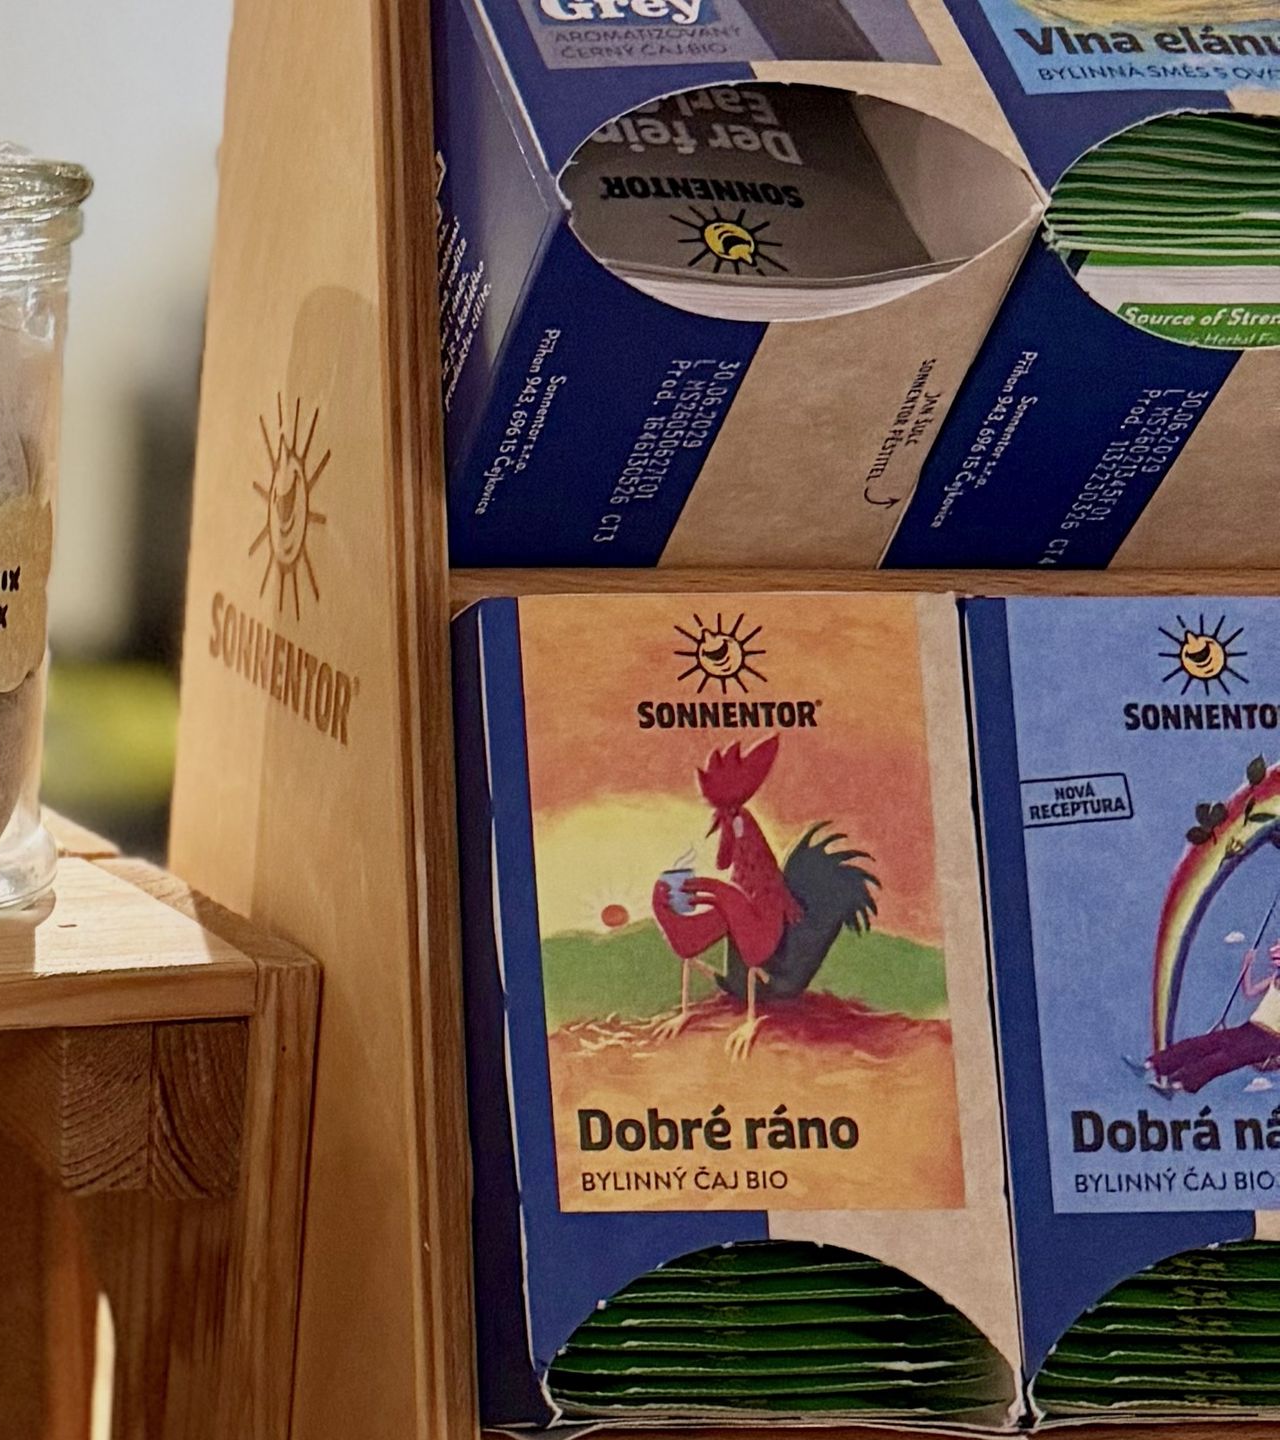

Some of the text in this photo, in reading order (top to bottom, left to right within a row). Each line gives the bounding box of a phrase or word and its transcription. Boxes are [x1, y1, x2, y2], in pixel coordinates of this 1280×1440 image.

[540, 0, 702, 25] Grey
[561, 42, 727, 60] ČERNÝ ČAJ BIO
[1014, 25, 1144, 56] Vlna
[1038, 61, 1141, 81] BYLINNÁ
[1146, 61, 1209, 79] SMĚS
[708, 123, 803, 166] Der
[606, 176, 805, 208] SONNENTOR
[1124, 306, 1196, 326] Source
[1200, 308, 1227, 326] of
[692, 359, 717, 368] L
[512, 377, 543, 408] 943,
[652, 360, 691, 406] Prod.
[893, 358, 937, 427] SONNENTOR
[1162, 389, 1186, 397] L
[529, 375, 567, 443] Sonnentor
[682, 360, 740, 449] 30.06.2029
[918, 392, 942, 415] JAN
[983, 395, 1014, 426] 943,
[1119, 389, 1162, 430] Prod.
[505, 410, 528, 438] 696
[991, 395, 1039, 459] Sonnentor
[1141, 390, 1209, 473] 30.06.2029
[499, 439, 518, 454] 15
[970, 428, 996, 453] 696
[962, 455, 982, 469] 15
[474, 454, 515, 516] Čejkovice
[593, 514, 622, 543] CT3
[1038, 538, 1069, 564] CT4
[209, 591, 352, 747] SONNENTOR
[637, 701, 818, 729] SONNENTOR
[1123, 702, 1280, 731] SONNENTO
[1054, 782, 1096, 801] NOVÁ
[1029, 797, 1127, 821] RECEPTURA
[577, 1104, 859, 1153] Dobré ráno
[1071, 1105, 1221, 1153] Dobrá
[581, 1166, 789, 1193] BYLINNÝ ČAJ BIO
[1075, 1166, 1276, 1193] BYLINNÝ ČAJ BIO
